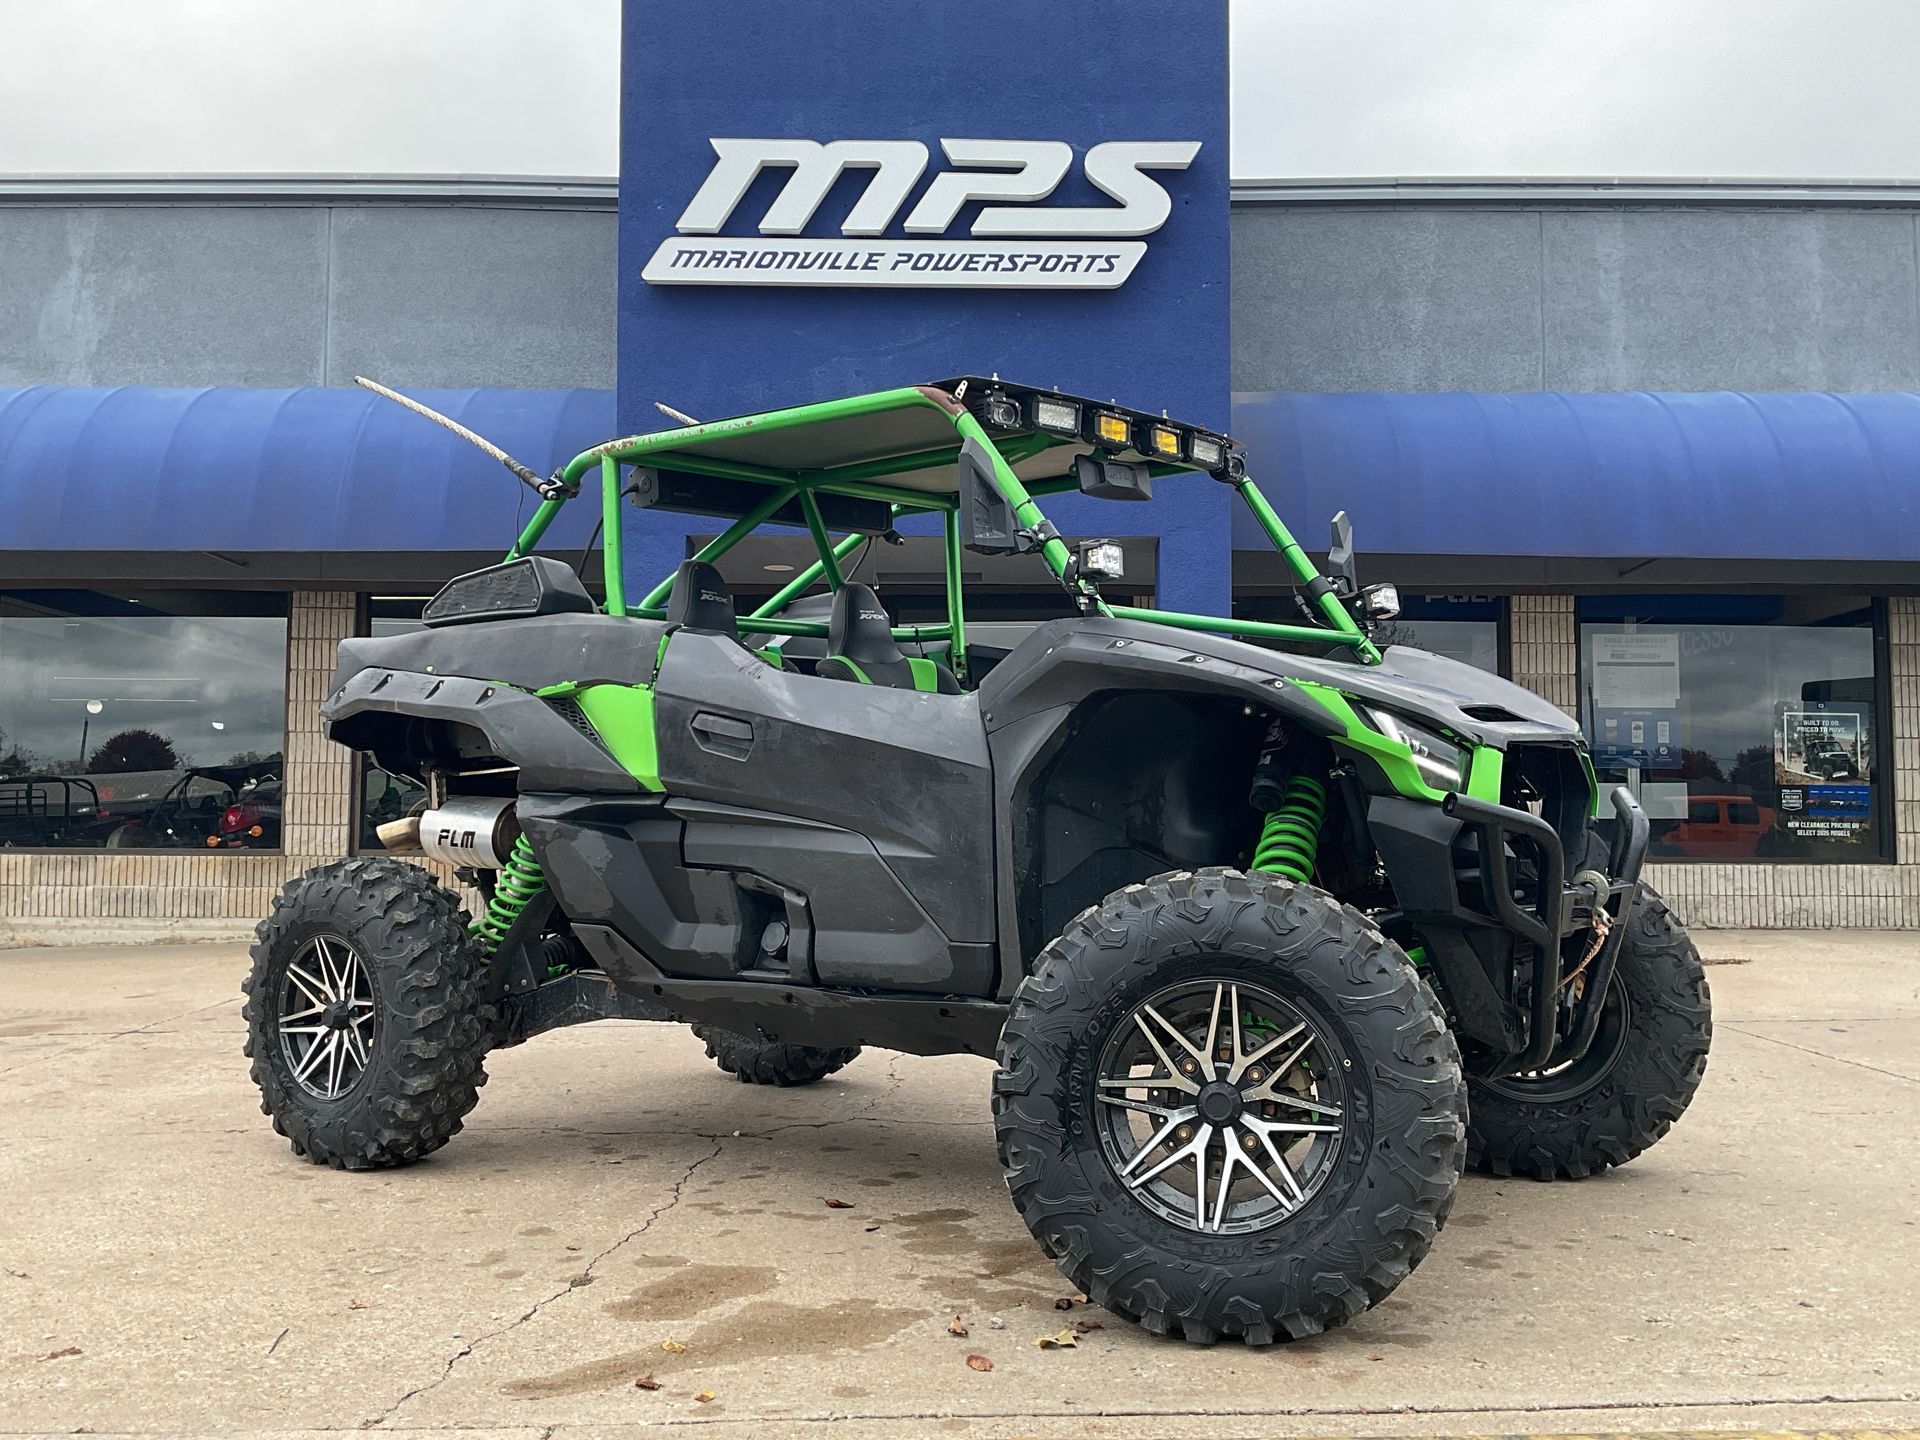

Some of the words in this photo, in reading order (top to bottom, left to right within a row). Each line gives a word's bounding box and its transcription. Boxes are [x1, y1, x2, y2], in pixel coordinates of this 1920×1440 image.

[675, 138, 1202, 236] MPS
[670, 249, 886, 271] MARIONVILLE
[889, 252, 1121, 273] POWERSPORTS
